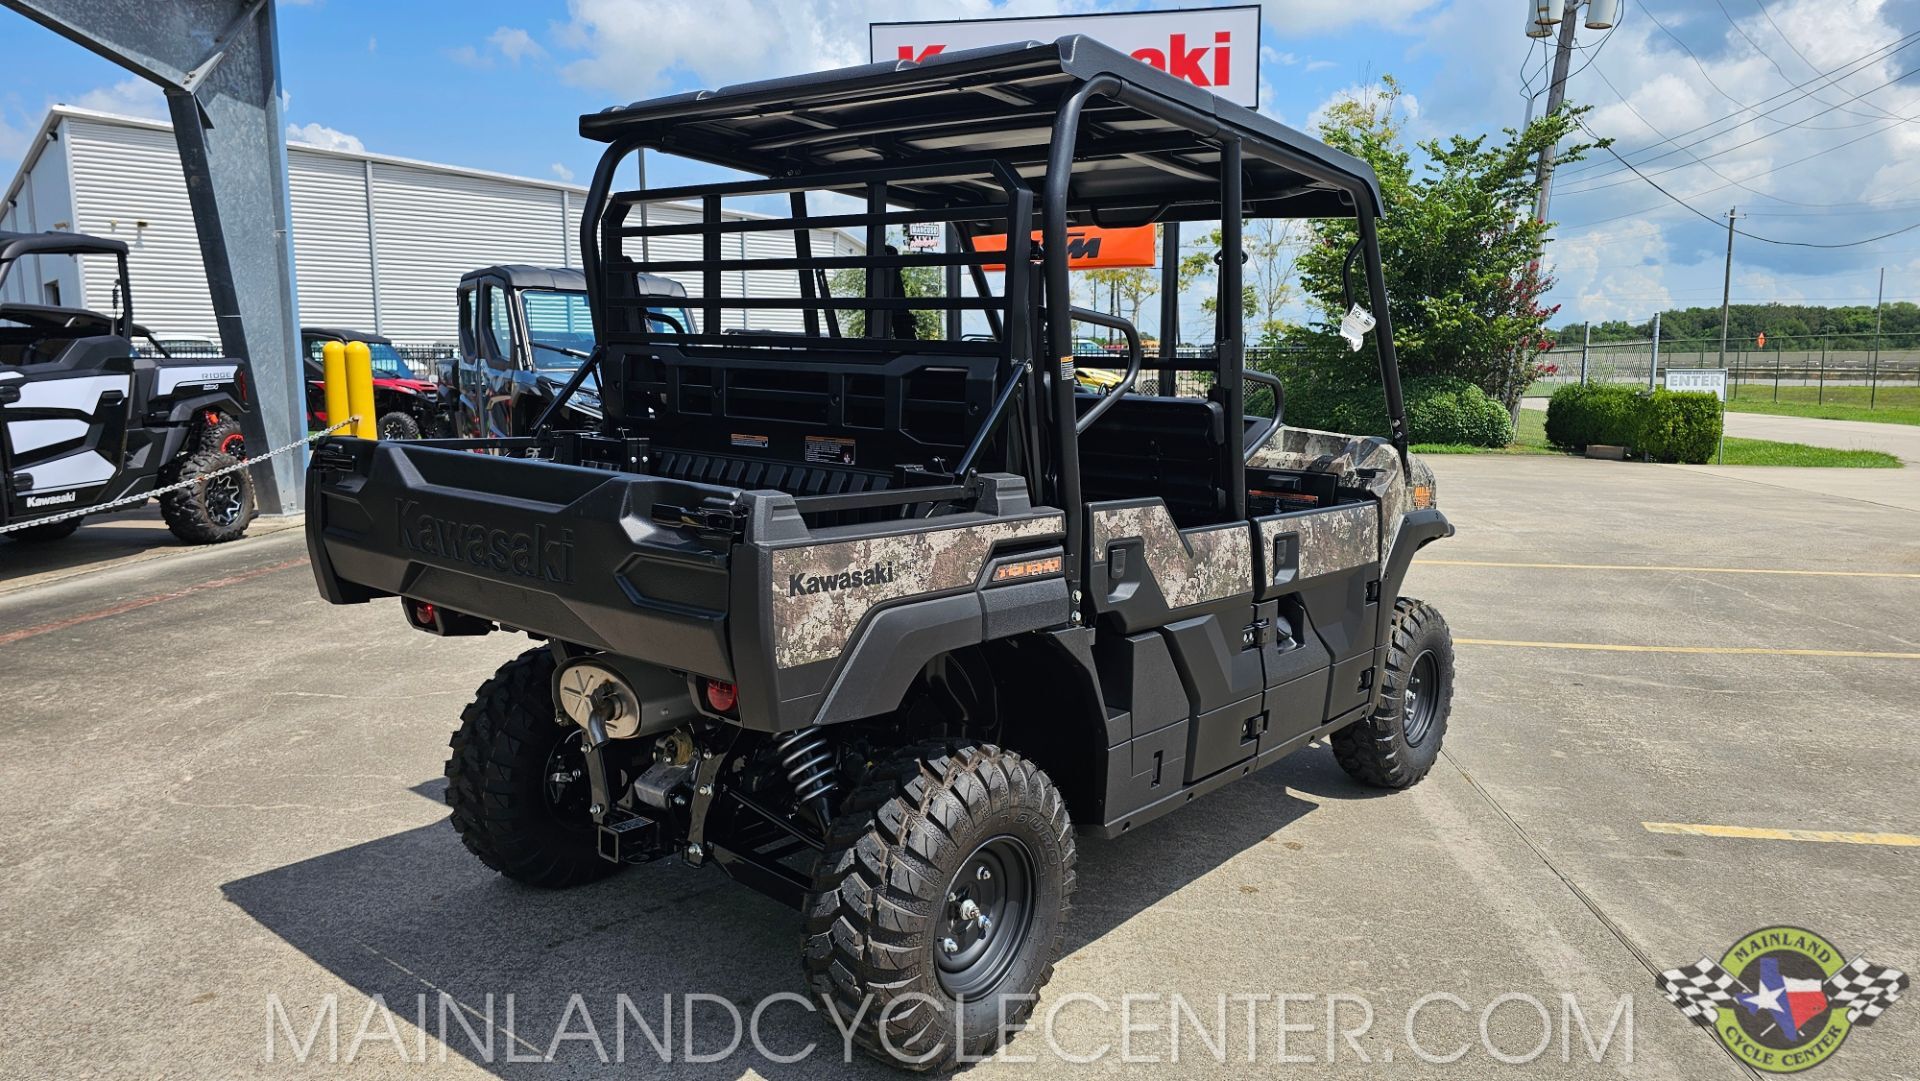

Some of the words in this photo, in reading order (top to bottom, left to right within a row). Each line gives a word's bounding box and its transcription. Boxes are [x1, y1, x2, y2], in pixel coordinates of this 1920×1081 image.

[1670, 376, 1721, 387] ENTER
[27, 491, 76, 508] Kawasaki
[395, 497, 576, 585] Kawasaki
[789, 561, 893, 596] Kawasaki
